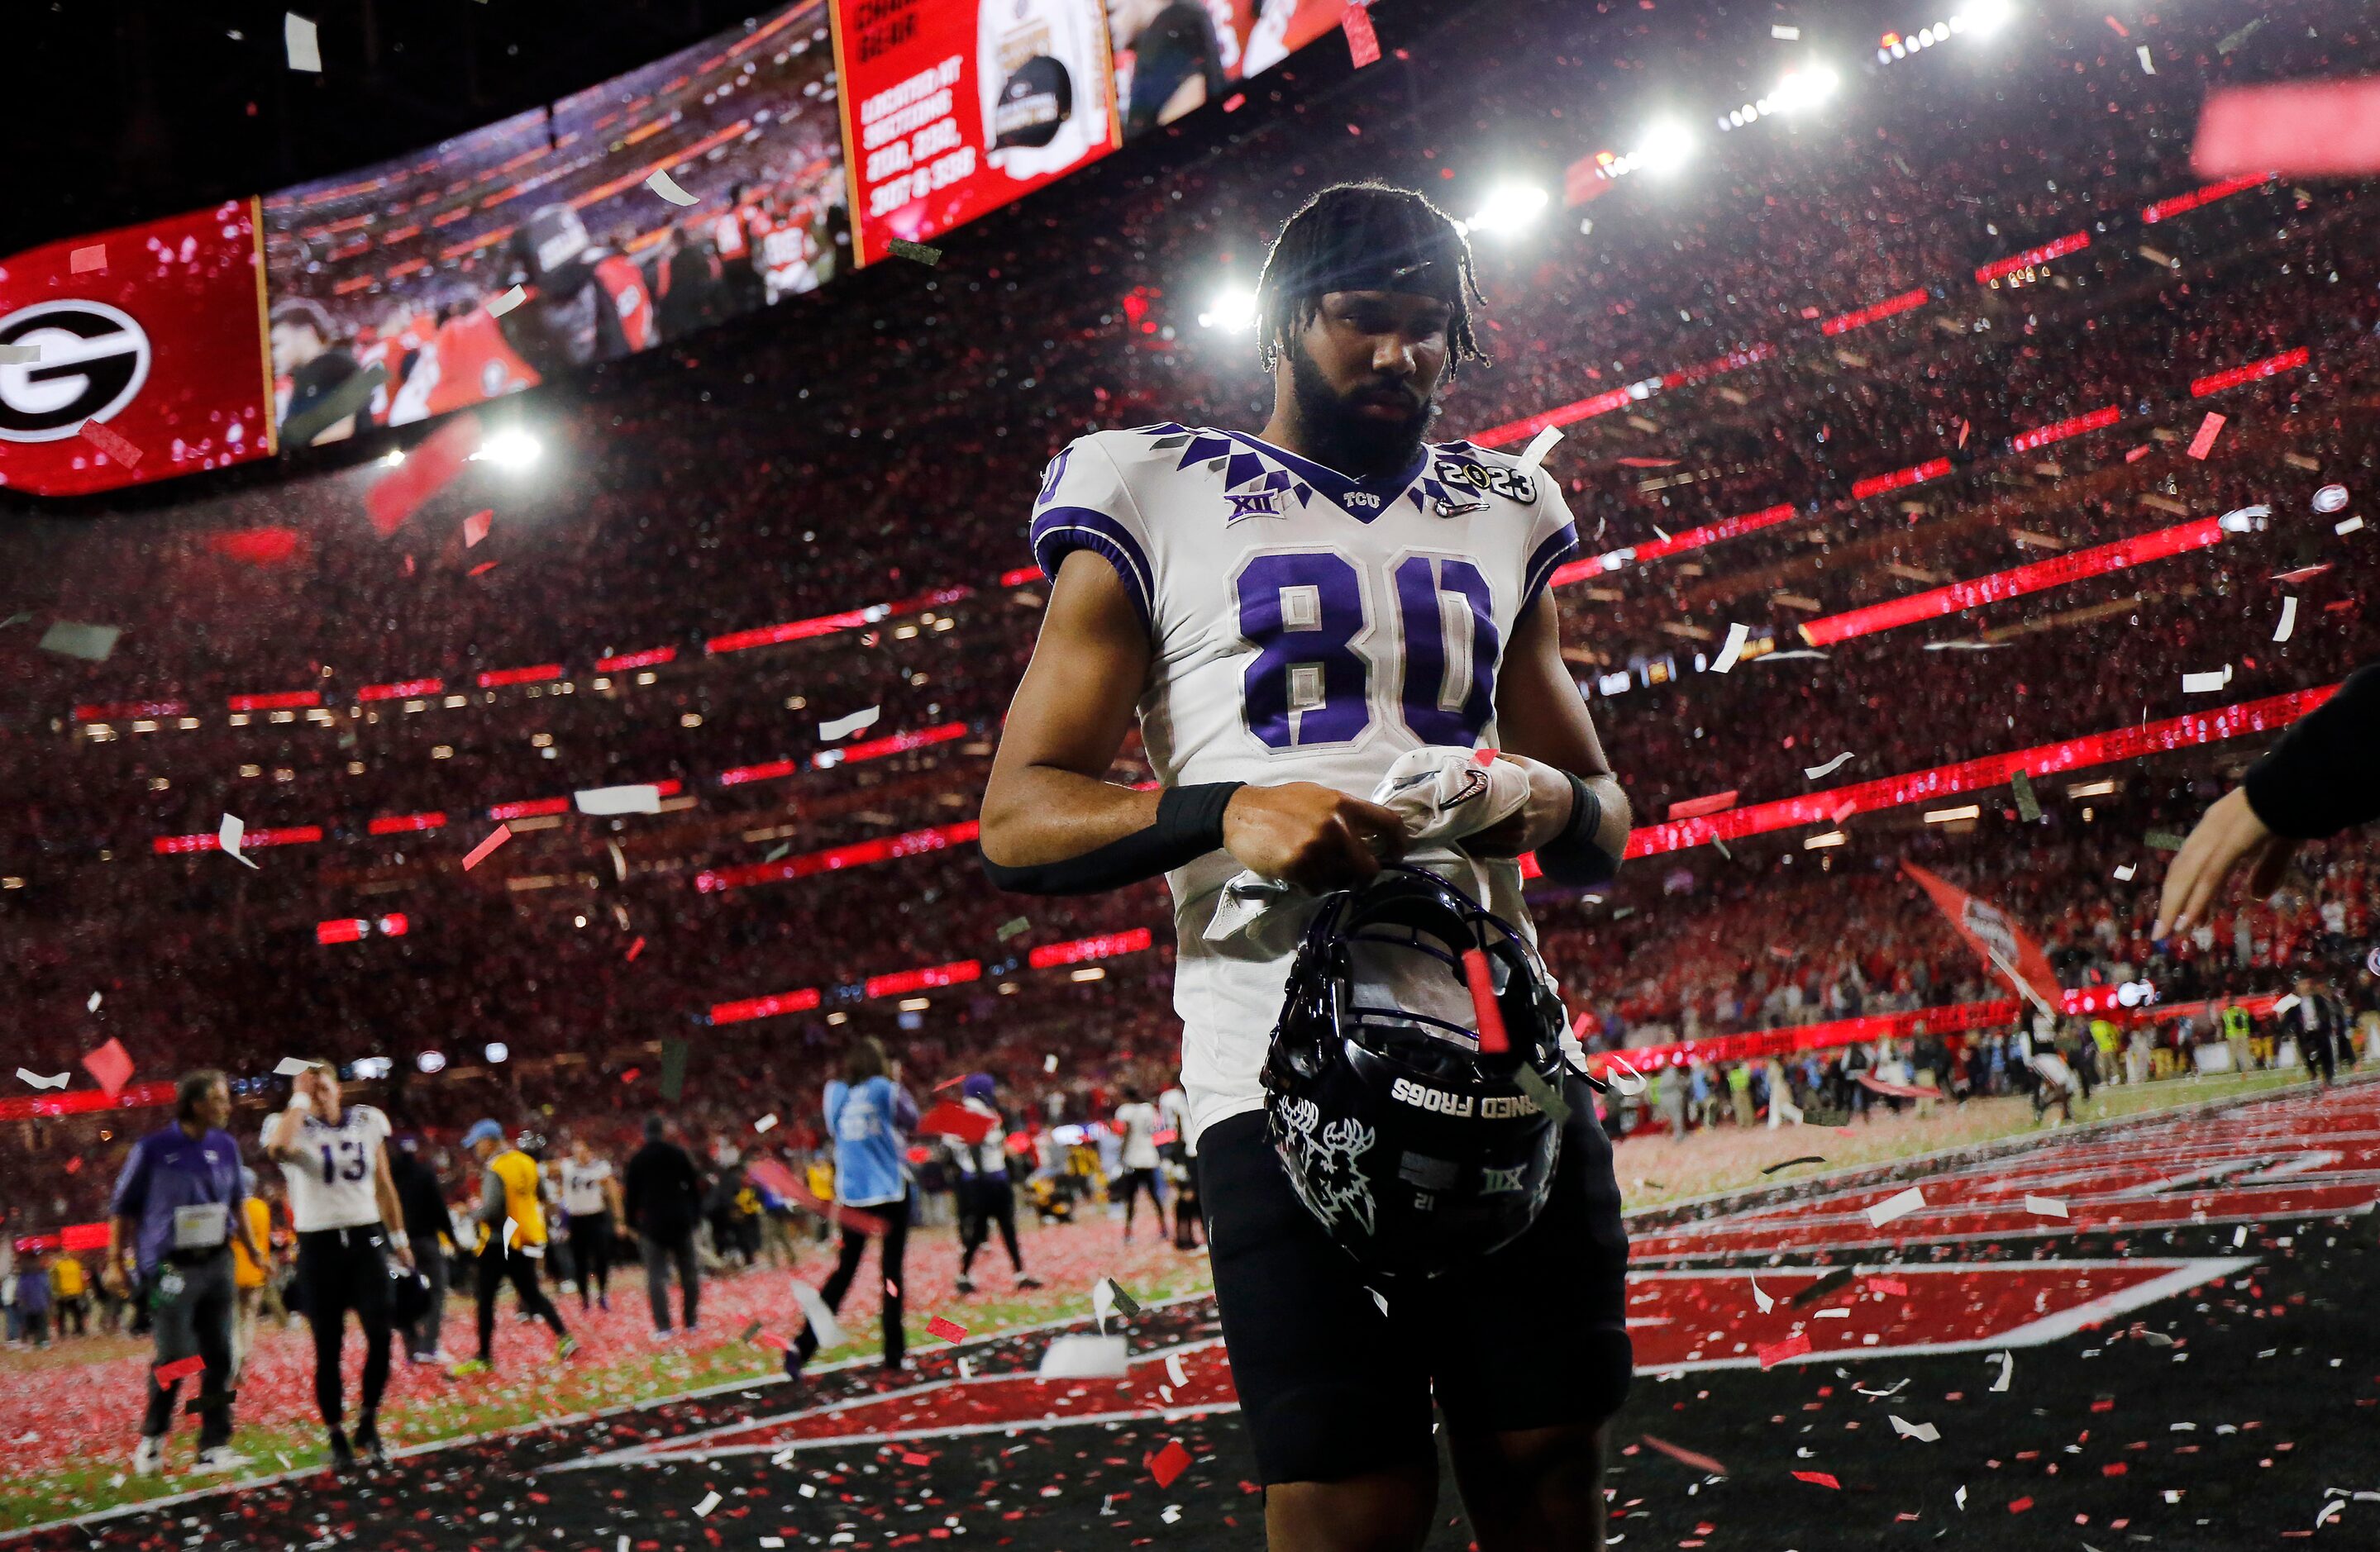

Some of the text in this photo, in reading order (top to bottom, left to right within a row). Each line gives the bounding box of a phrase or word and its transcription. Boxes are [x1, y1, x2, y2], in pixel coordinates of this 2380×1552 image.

[1223, 491, 1282, 525] XII
[1343, 492, 1381, 509] TCU
[1233, 549, 1501, 750] 80
[1391, 1078, 1474, 1119] FROGS
[320, 1140, 367, 1185] 13
